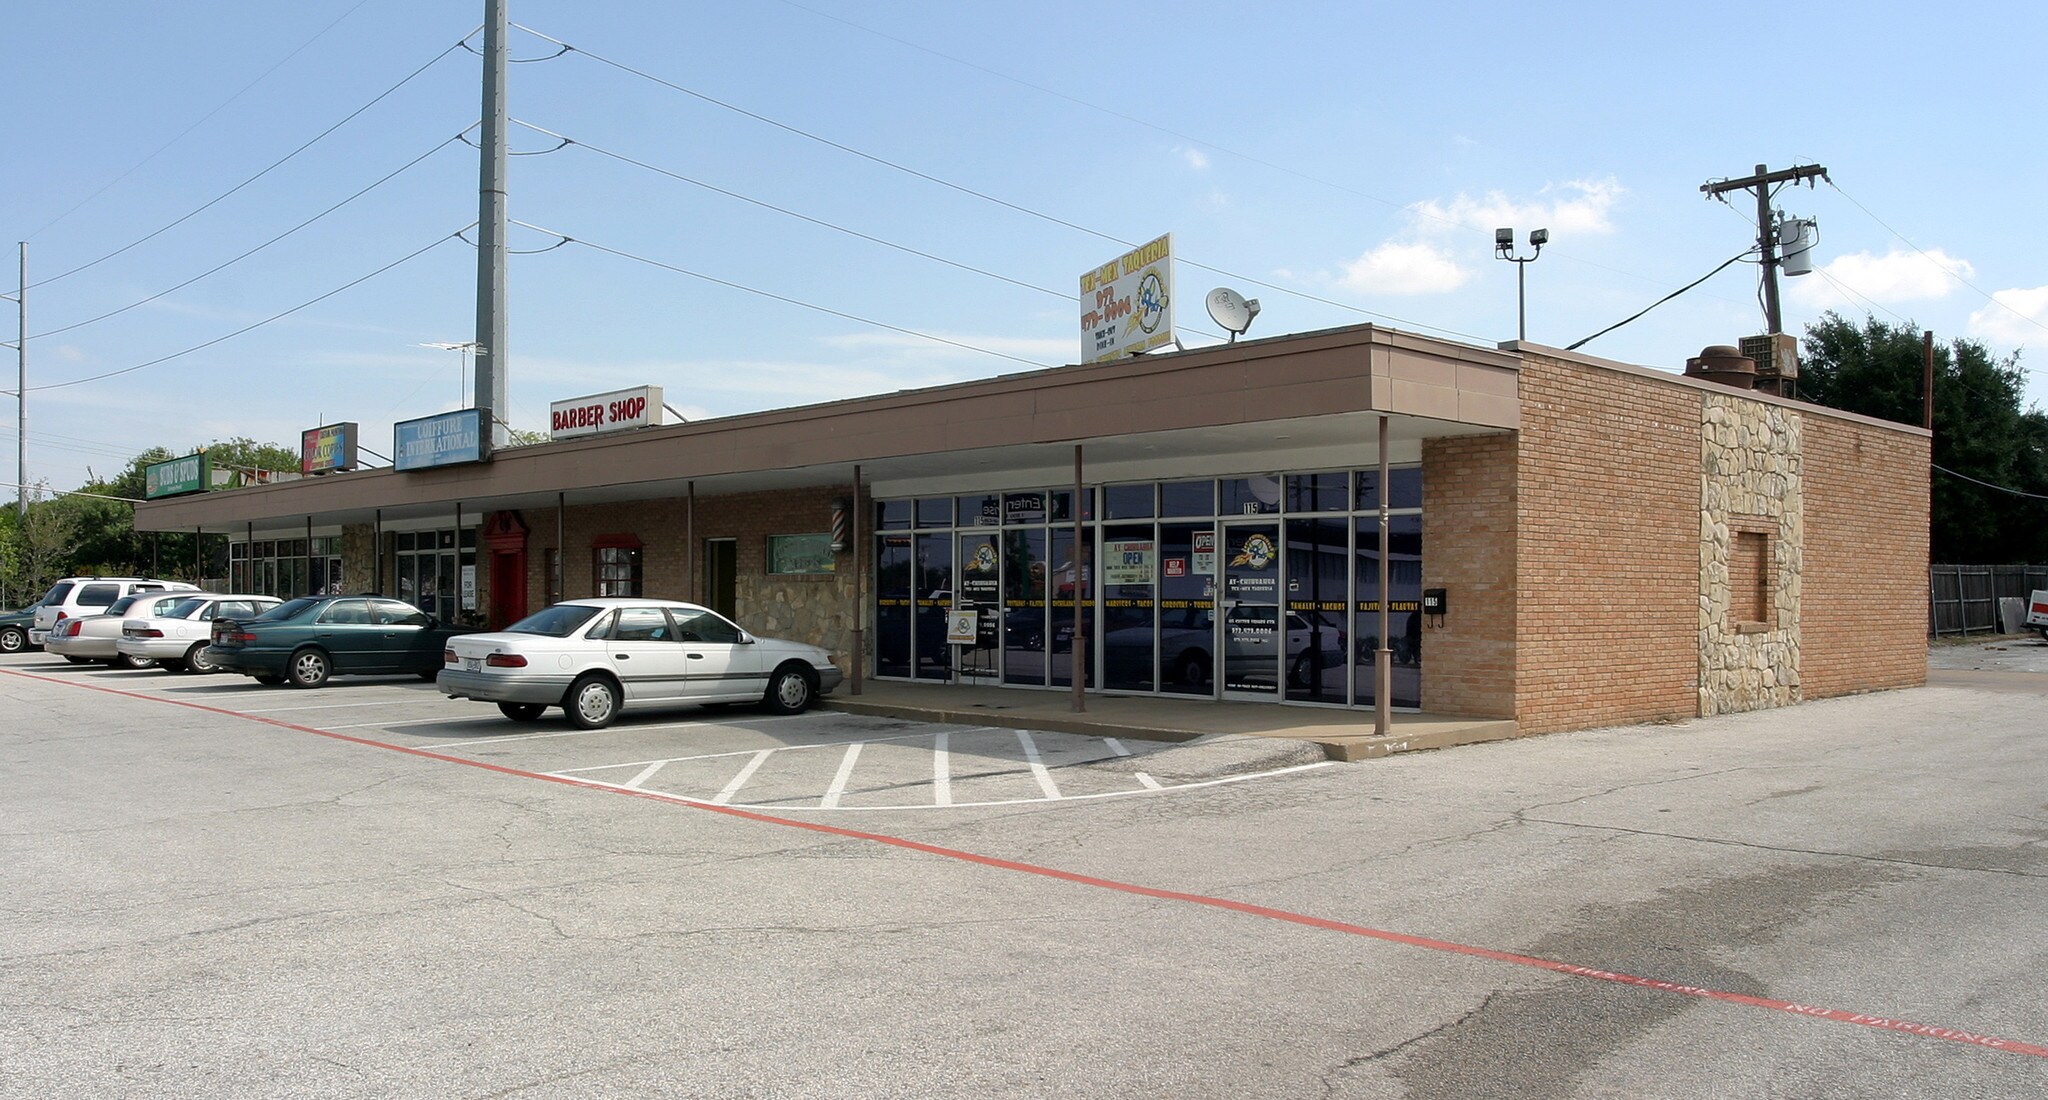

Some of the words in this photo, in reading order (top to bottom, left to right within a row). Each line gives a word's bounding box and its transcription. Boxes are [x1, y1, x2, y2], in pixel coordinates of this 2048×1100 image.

[1122, 236, 1169, 275] TAQUERIA
[553, 404, 604, 431] BARBER
[609, 396, 645, 422] SHOP
[417, 416, 463, 439] COIFFURE
[406, 432, 476, 457] INTERNATIONAL
[1244, 503, 1258, 514] 115
[1195, 536, 1215, 549] OPEN
[1123, 552, 1143, 565] OPEN
[1290, 602, 1316, 610] TAMALES
[1322, 602, 1345, 610] NACHOS
[1360, 602, 1380, 610] FAJITA
[1391, 602, 1418, 610] FLAUTAS
[1425, 597, 1437, 606] 115
[1786, 1003, 1833, 1016] NO
[1850, 1014, 2008, 1046] PARKING
